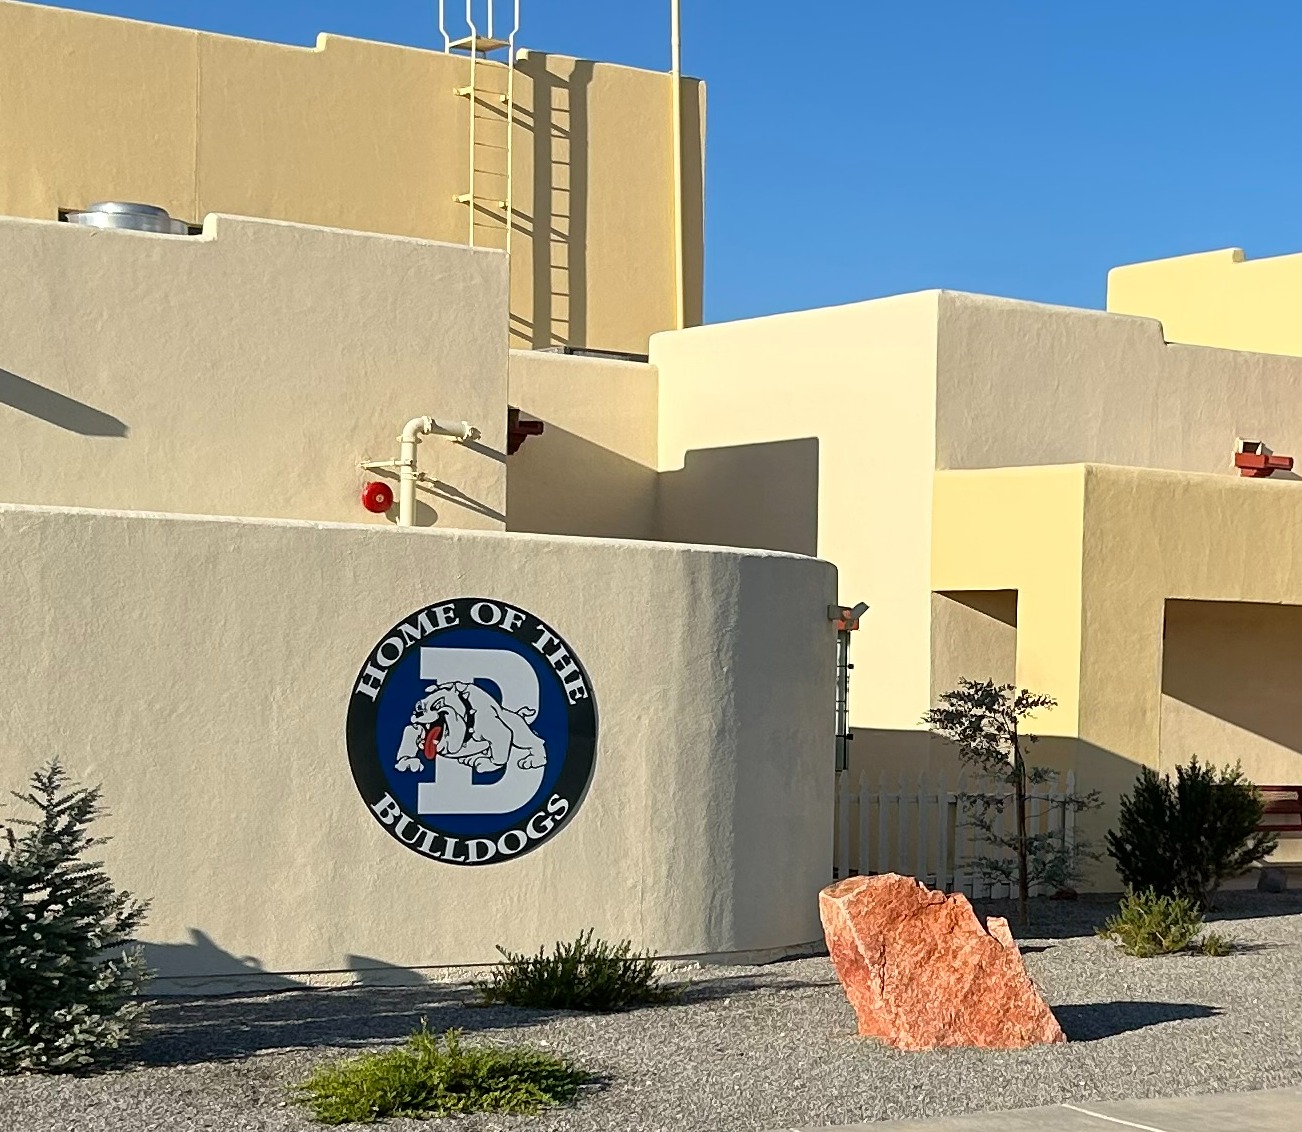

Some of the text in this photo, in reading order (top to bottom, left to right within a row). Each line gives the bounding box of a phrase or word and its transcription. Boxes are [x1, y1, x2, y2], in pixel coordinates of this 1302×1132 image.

[355, 601, 589, 706] HOME OF THE
[417, 646, 546, 815] B
[370, 792, 570, 863] BULLDOGS
